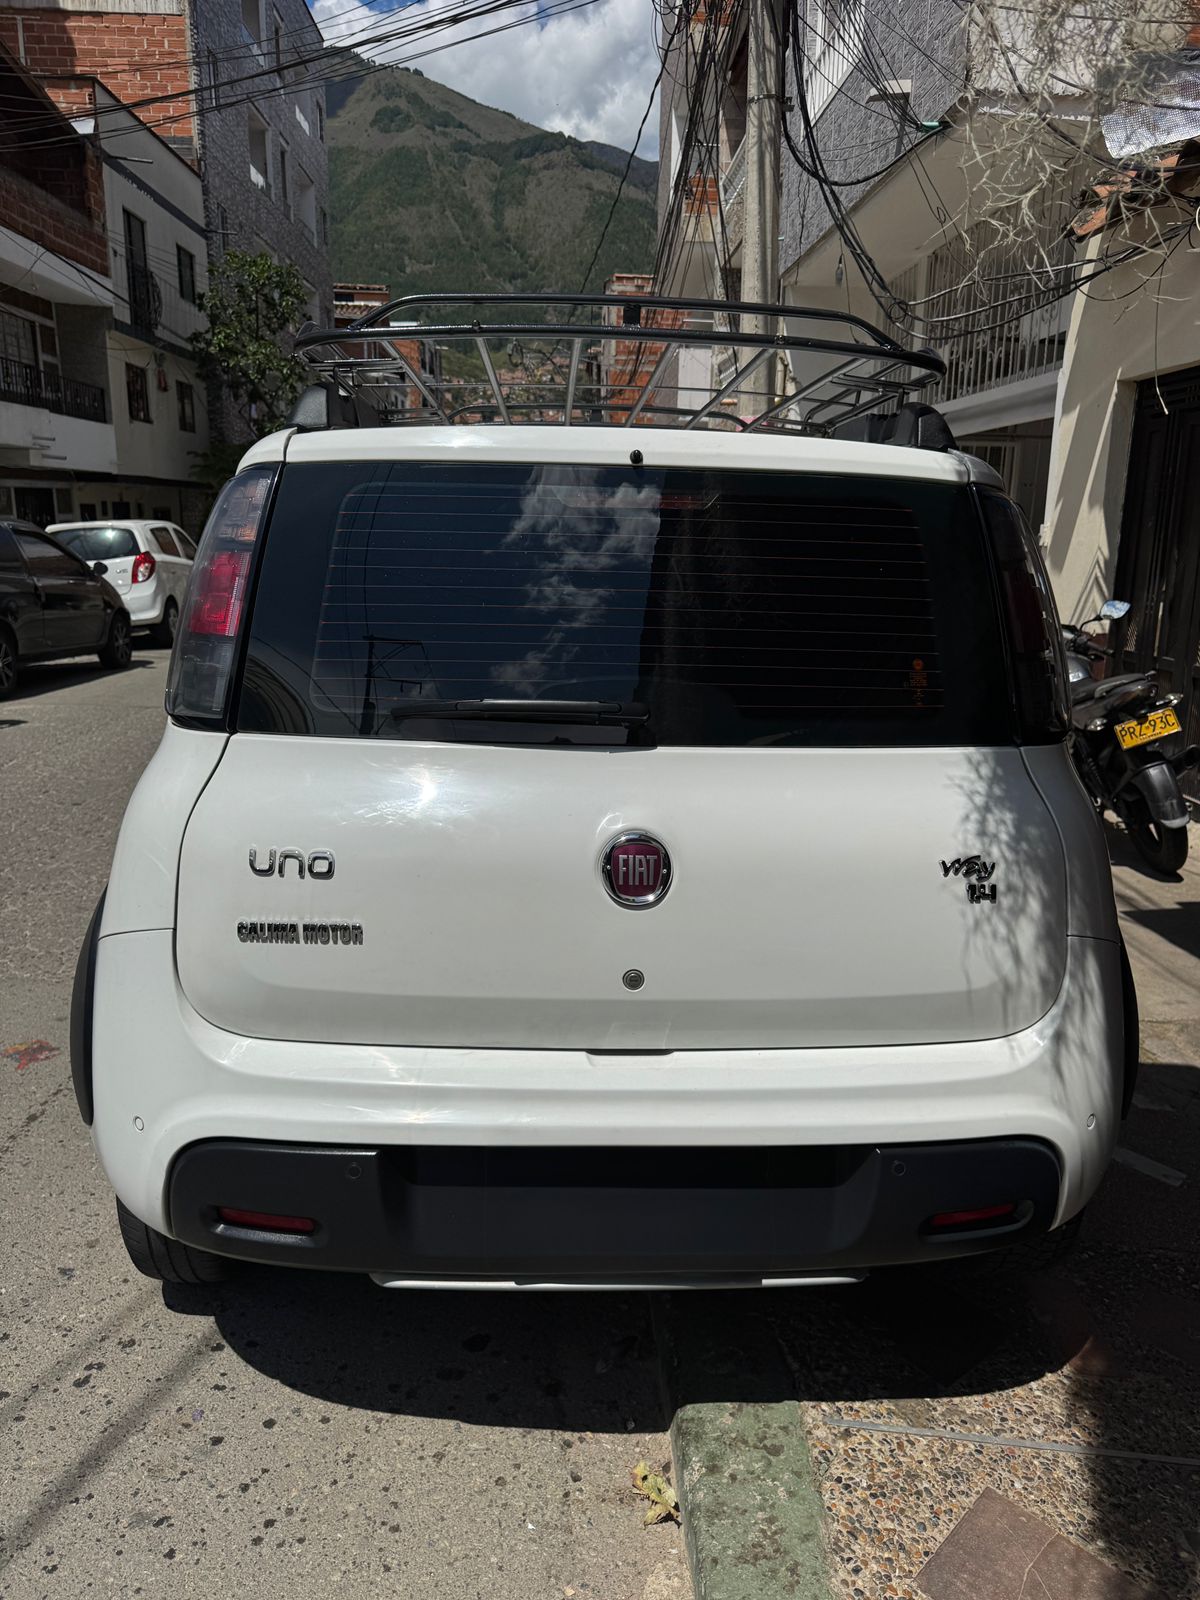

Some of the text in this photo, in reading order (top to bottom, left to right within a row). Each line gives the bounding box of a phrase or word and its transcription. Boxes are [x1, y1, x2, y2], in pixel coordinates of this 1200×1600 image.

[618, 854, 658, 886] FIAT
[237, 920, 364, 945] CALIMA MOTOR
